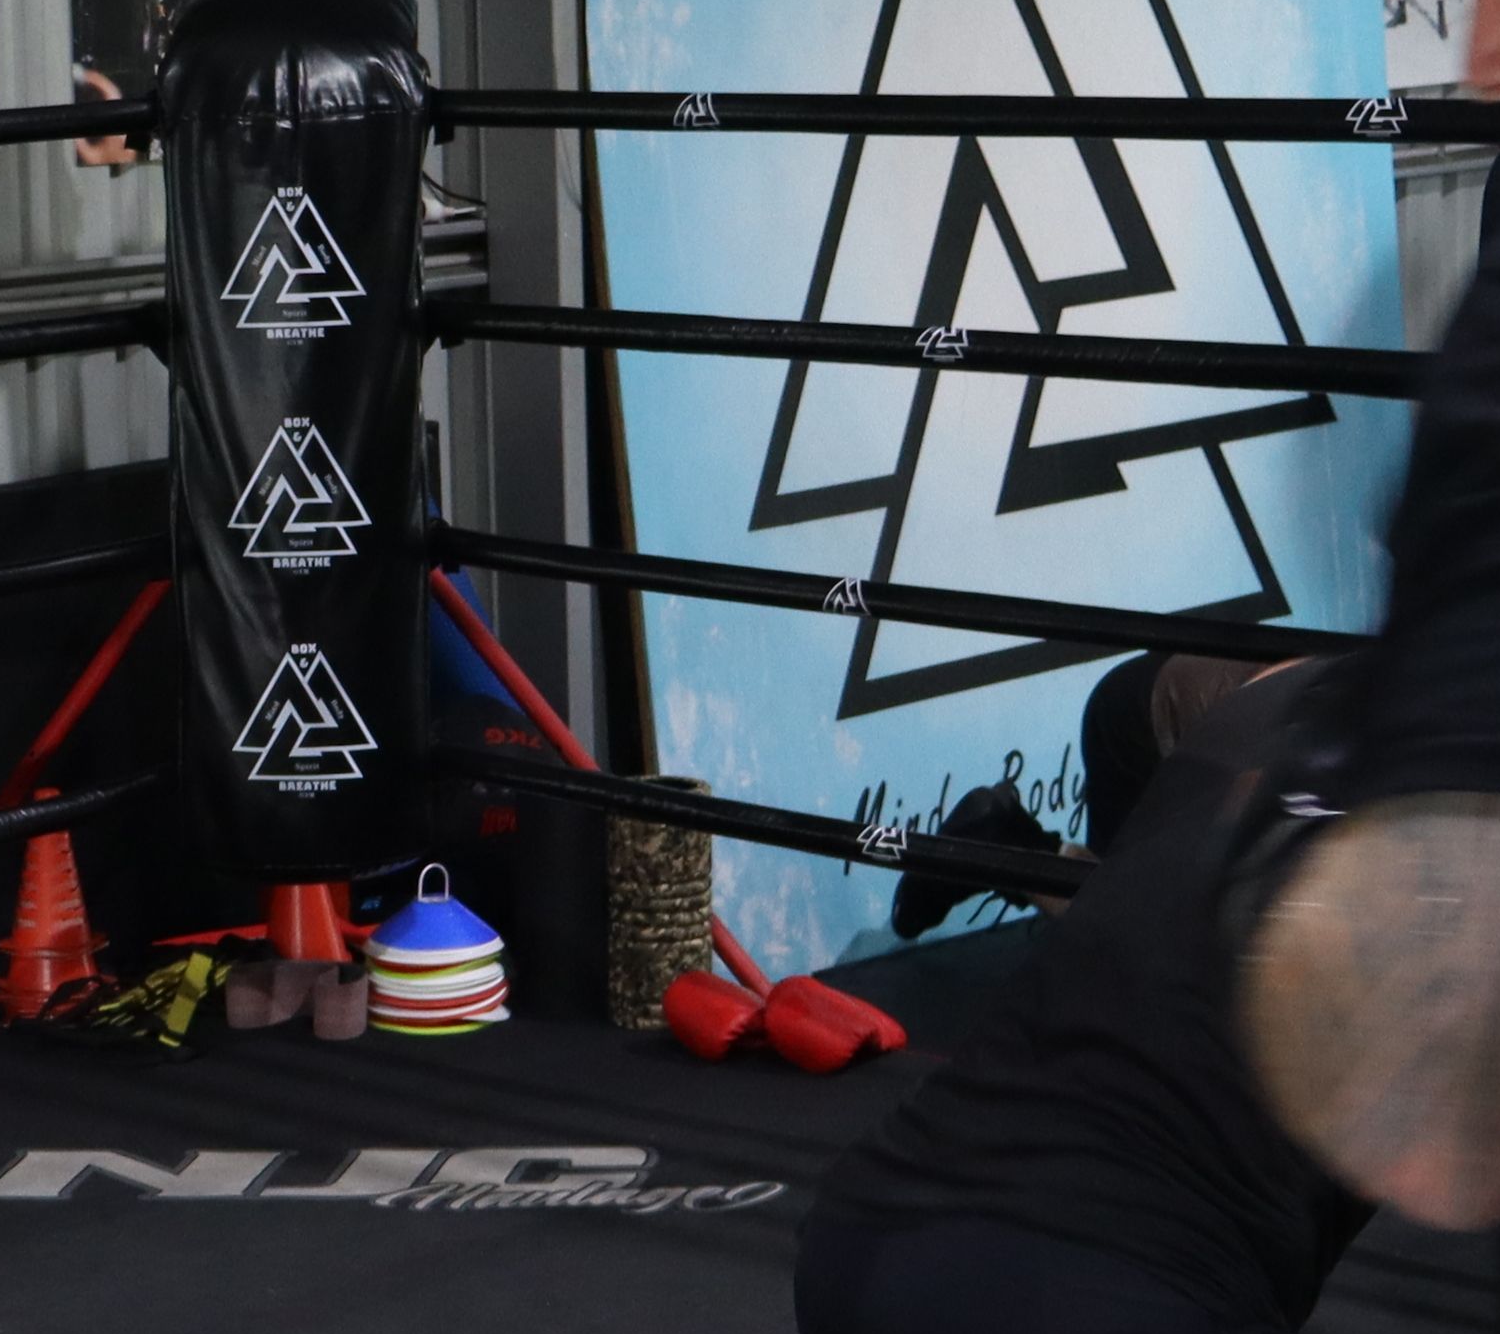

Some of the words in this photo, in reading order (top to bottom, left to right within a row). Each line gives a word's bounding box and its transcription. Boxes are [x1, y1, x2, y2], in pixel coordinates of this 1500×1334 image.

[277, 186, 303, 198] BOX
[266, 328, 325, 339] BREATHE
[284, 417, 310, 428] BOX
[272, 557, 331, 569] BREATHE
[291, 643, 317, 654] BOX
[278, 780, 337, 792] BREATHE
